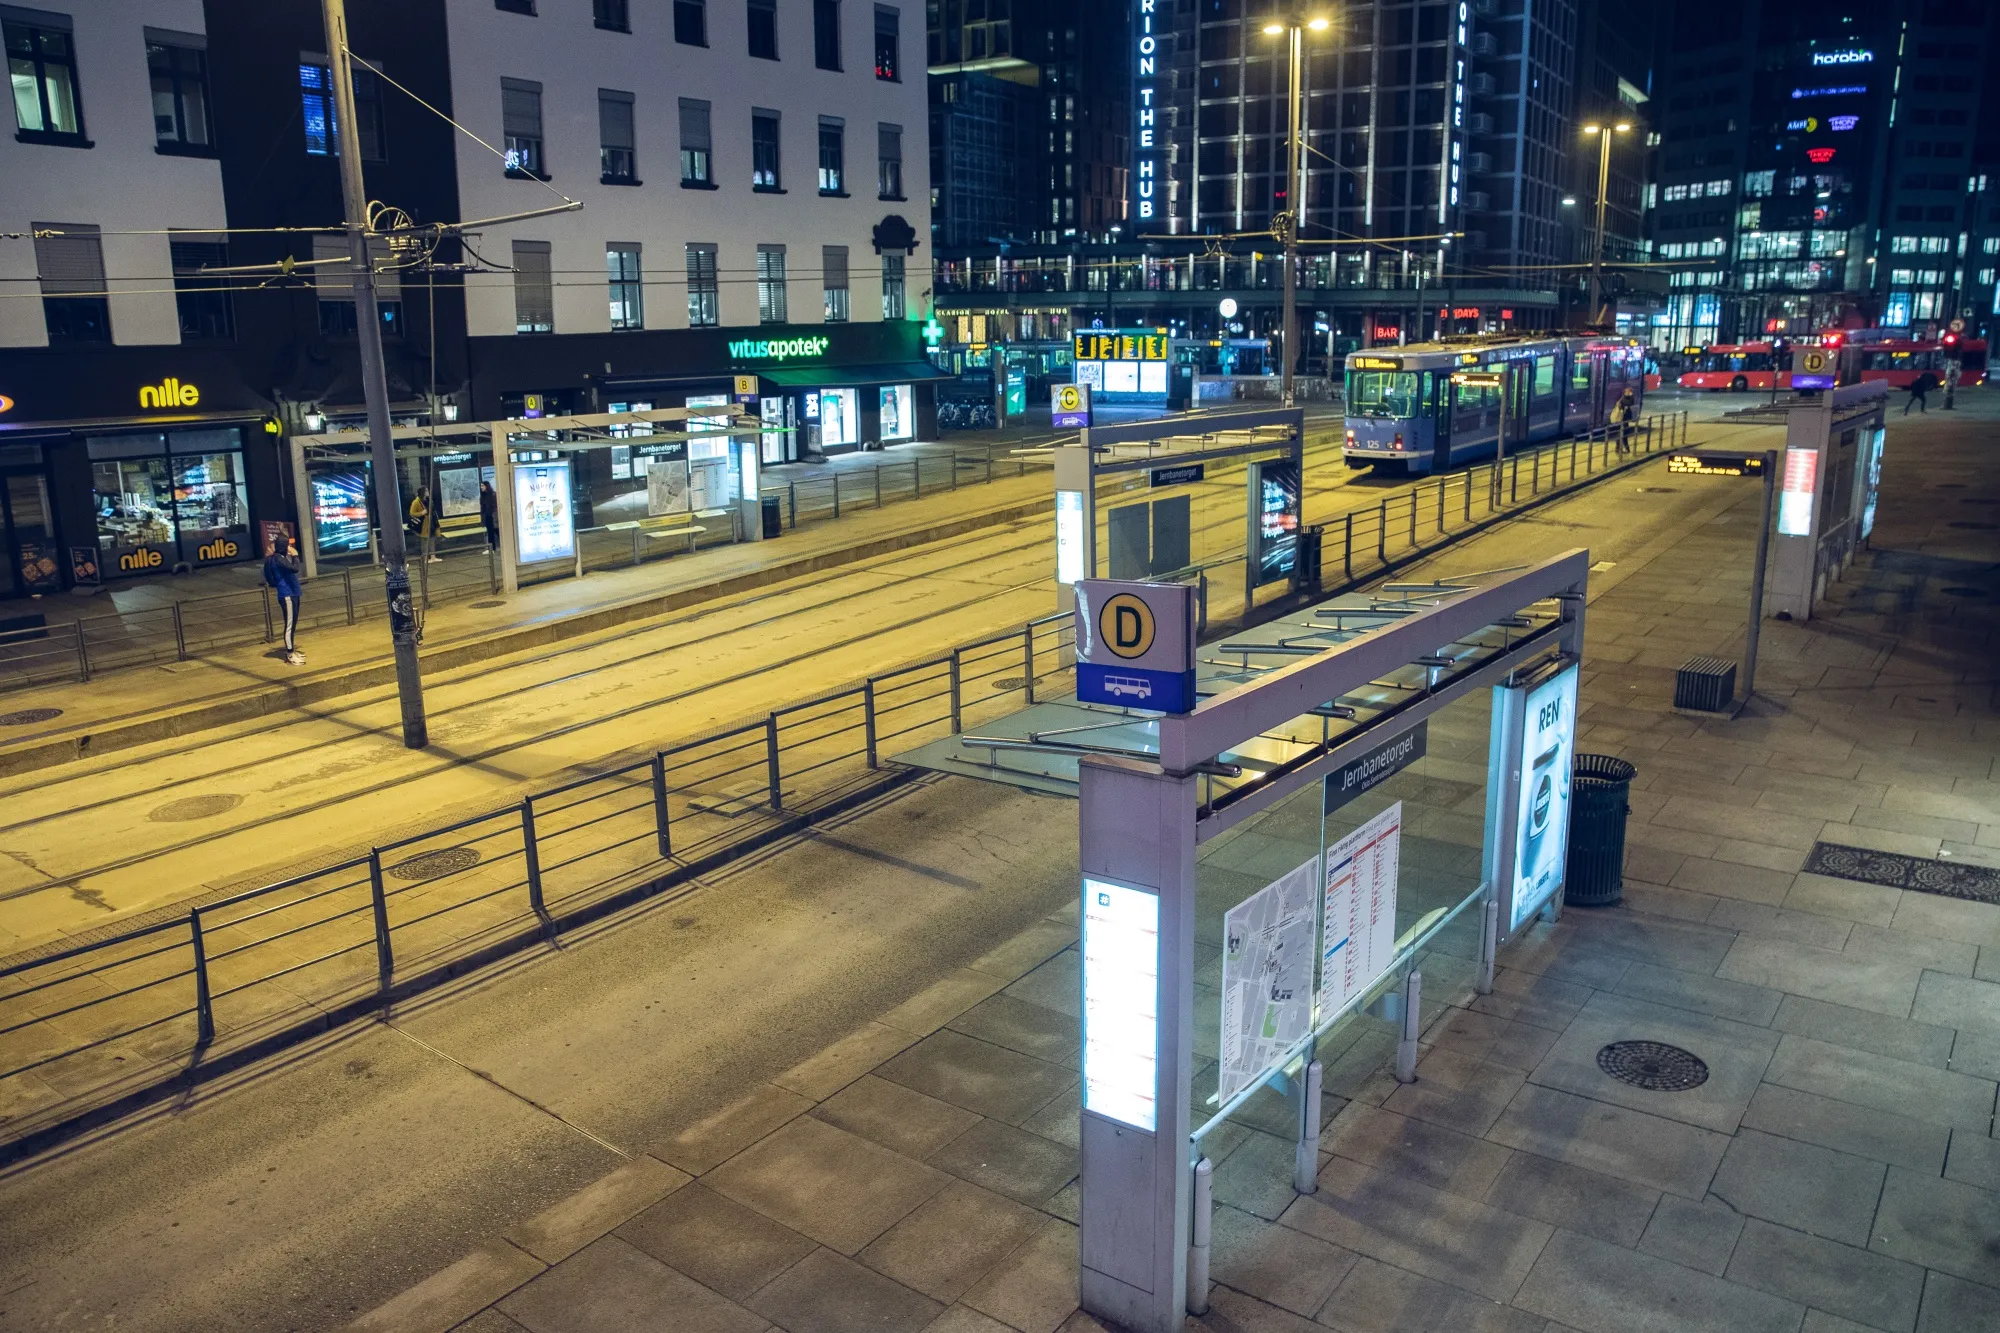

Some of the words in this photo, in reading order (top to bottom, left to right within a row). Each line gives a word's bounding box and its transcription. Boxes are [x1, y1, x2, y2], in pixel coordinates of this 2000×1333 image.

[1455, 60, 1465, 127] THE
[1140, 88, 1155, 148] THE
[1450, 140, 1461, 206] HUB
[1139, 161, 1154, 219] HUB
[1376, 326, 1399, 339] BAR
[1810, 356, 1821, 369] D
[139, 377, 200, 408] nille
[741, 379, 748, 390] B
[1065, 390, 1074, 406] C
[639, 443, 682, 454] Jernbanetorget
[1367, 440, 1380, 449] 125
[433, 453, 472, 463] ernbanetorget
[1159, 468, 1197, 481] Jernbanetorget
[320, 497, 347, 506] Brands
[1264, 499, 1285, 513] Brands
[119, 547, 164, 571] nille
[197, 538, 239, 562] nille
[1116, 605, 1142, 648] D
[1538, 698, 1560, 733] REN
[1341, 734, 1414, 792] Jernbanetorget
